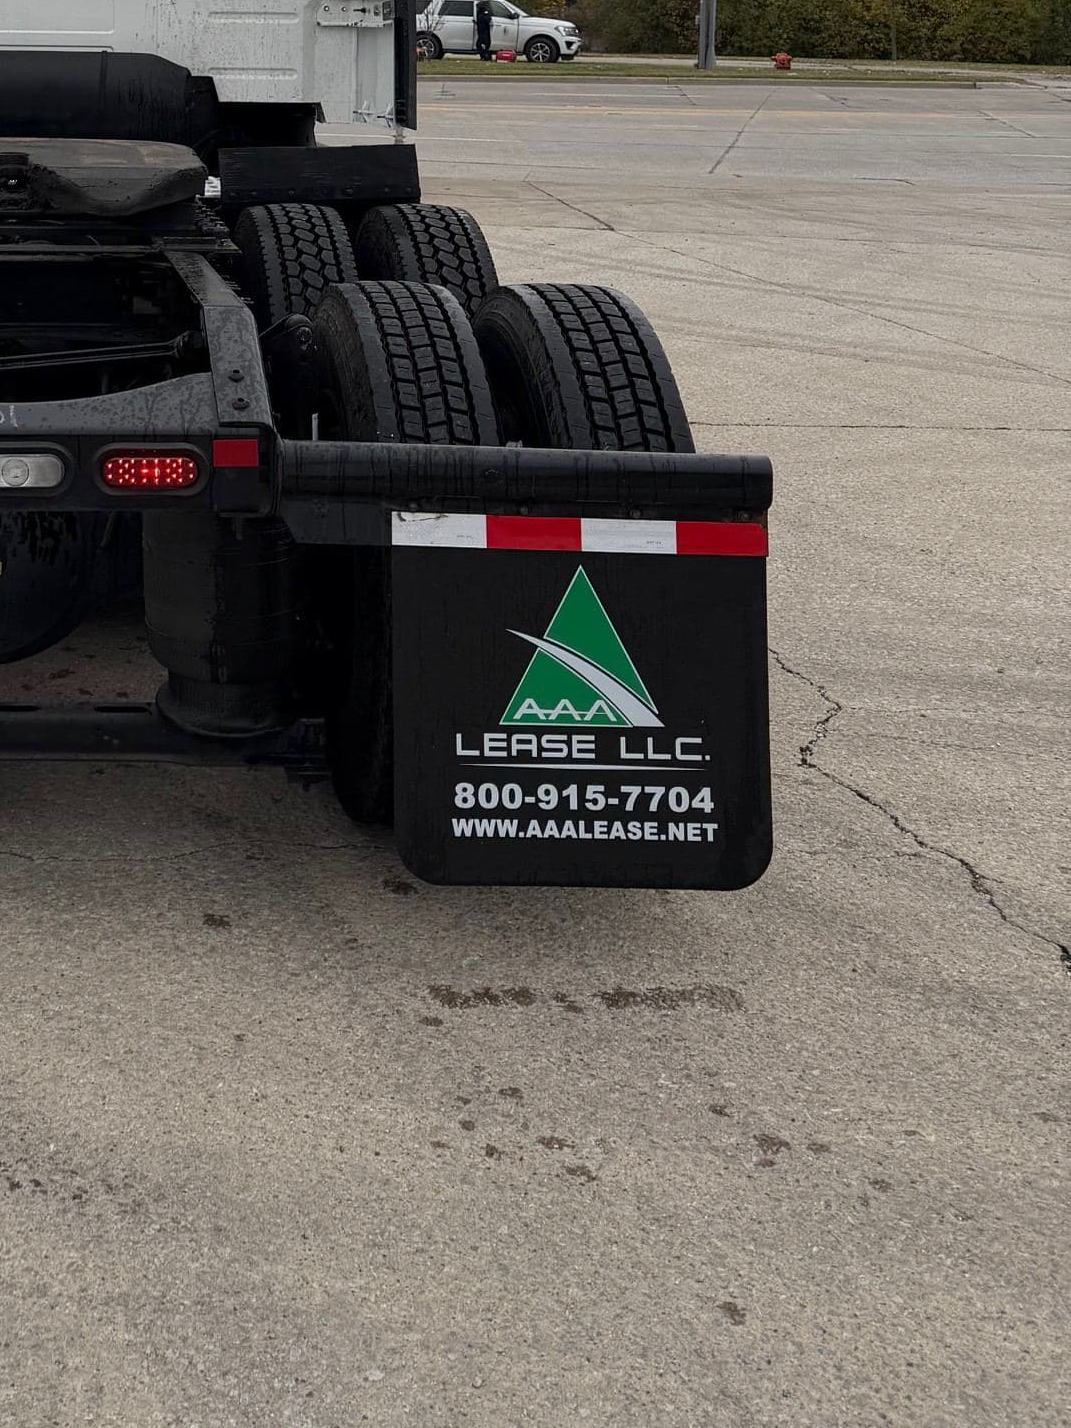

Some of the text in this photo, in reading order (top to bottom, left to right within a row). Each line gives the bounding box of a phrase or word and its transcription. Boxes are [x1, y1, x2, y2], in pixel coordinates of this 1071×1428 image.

[512, 698, 618, 722] AAA
[455, 732, 711, 761] LEASE LLC.
[454, 782, 715, 814] 800-915-7704
[451, 818, 719, 843] WWW.AAALEASE.NET
